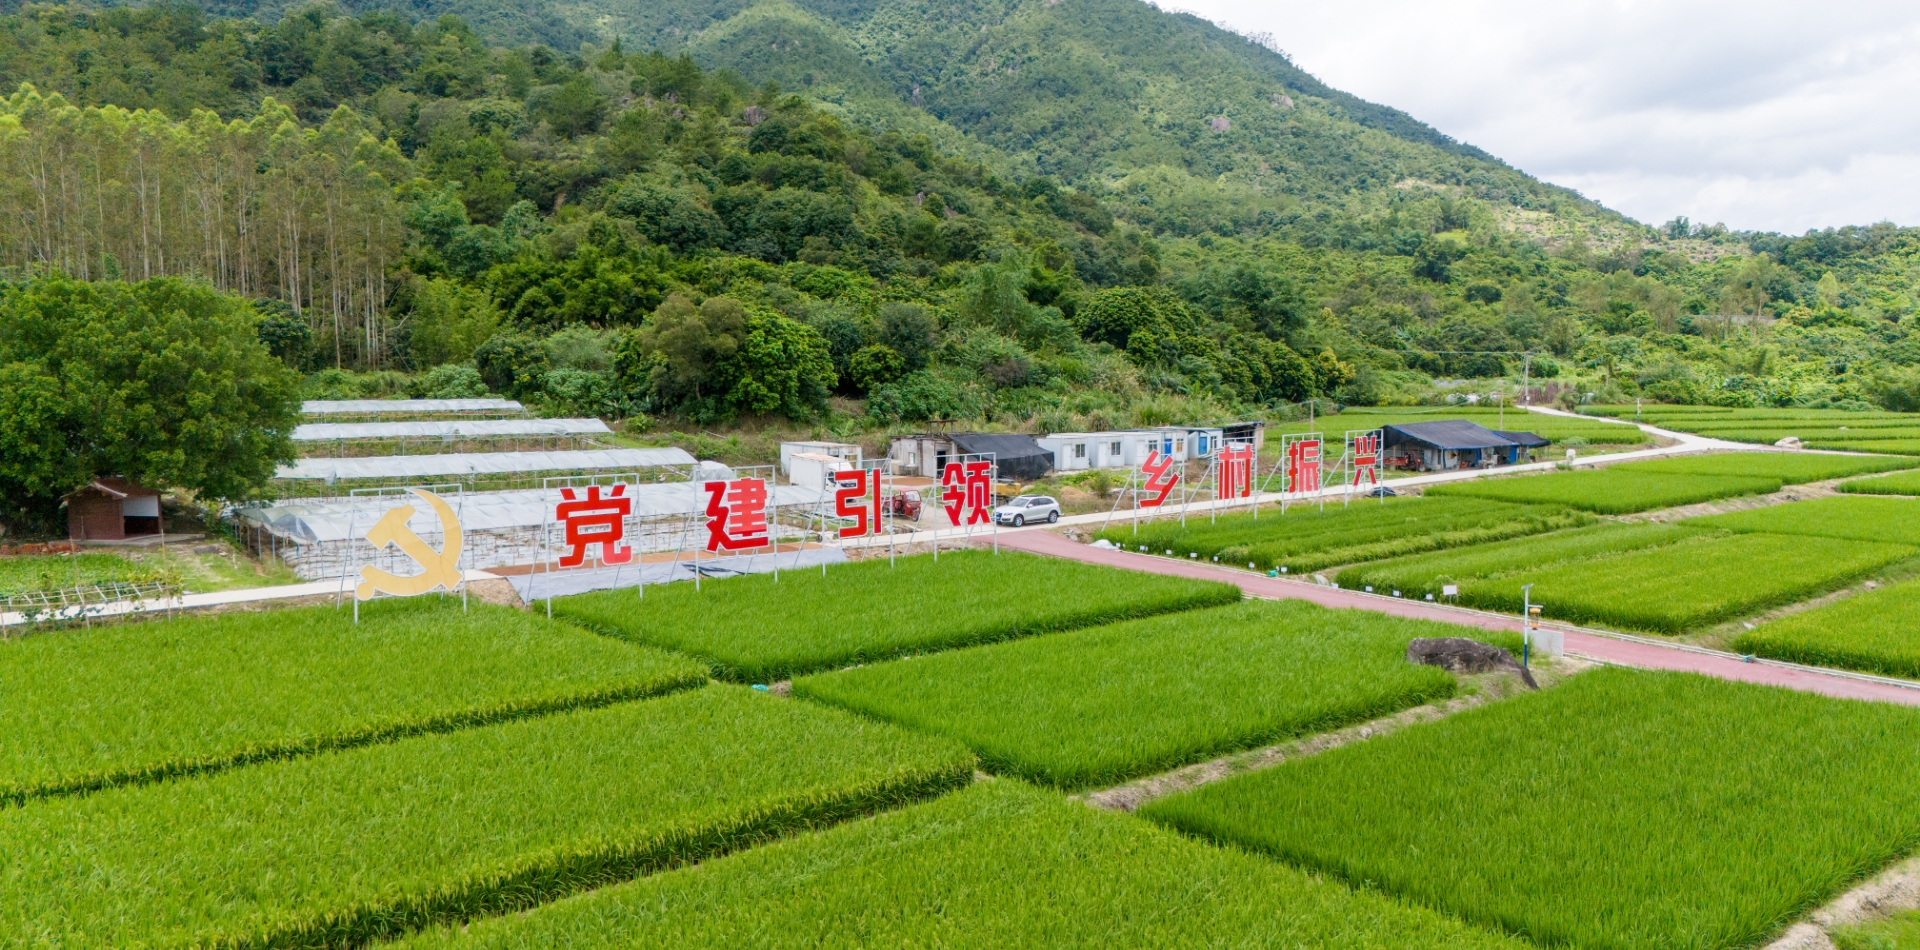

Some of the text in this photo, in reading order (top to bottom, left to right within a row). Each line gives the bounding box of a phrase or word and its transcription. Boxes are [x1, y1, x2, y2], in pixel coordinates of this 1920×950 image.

[555, 460, 992, 568] 党建引领
[1138, 435, 1377, 508] 乡村振兴
